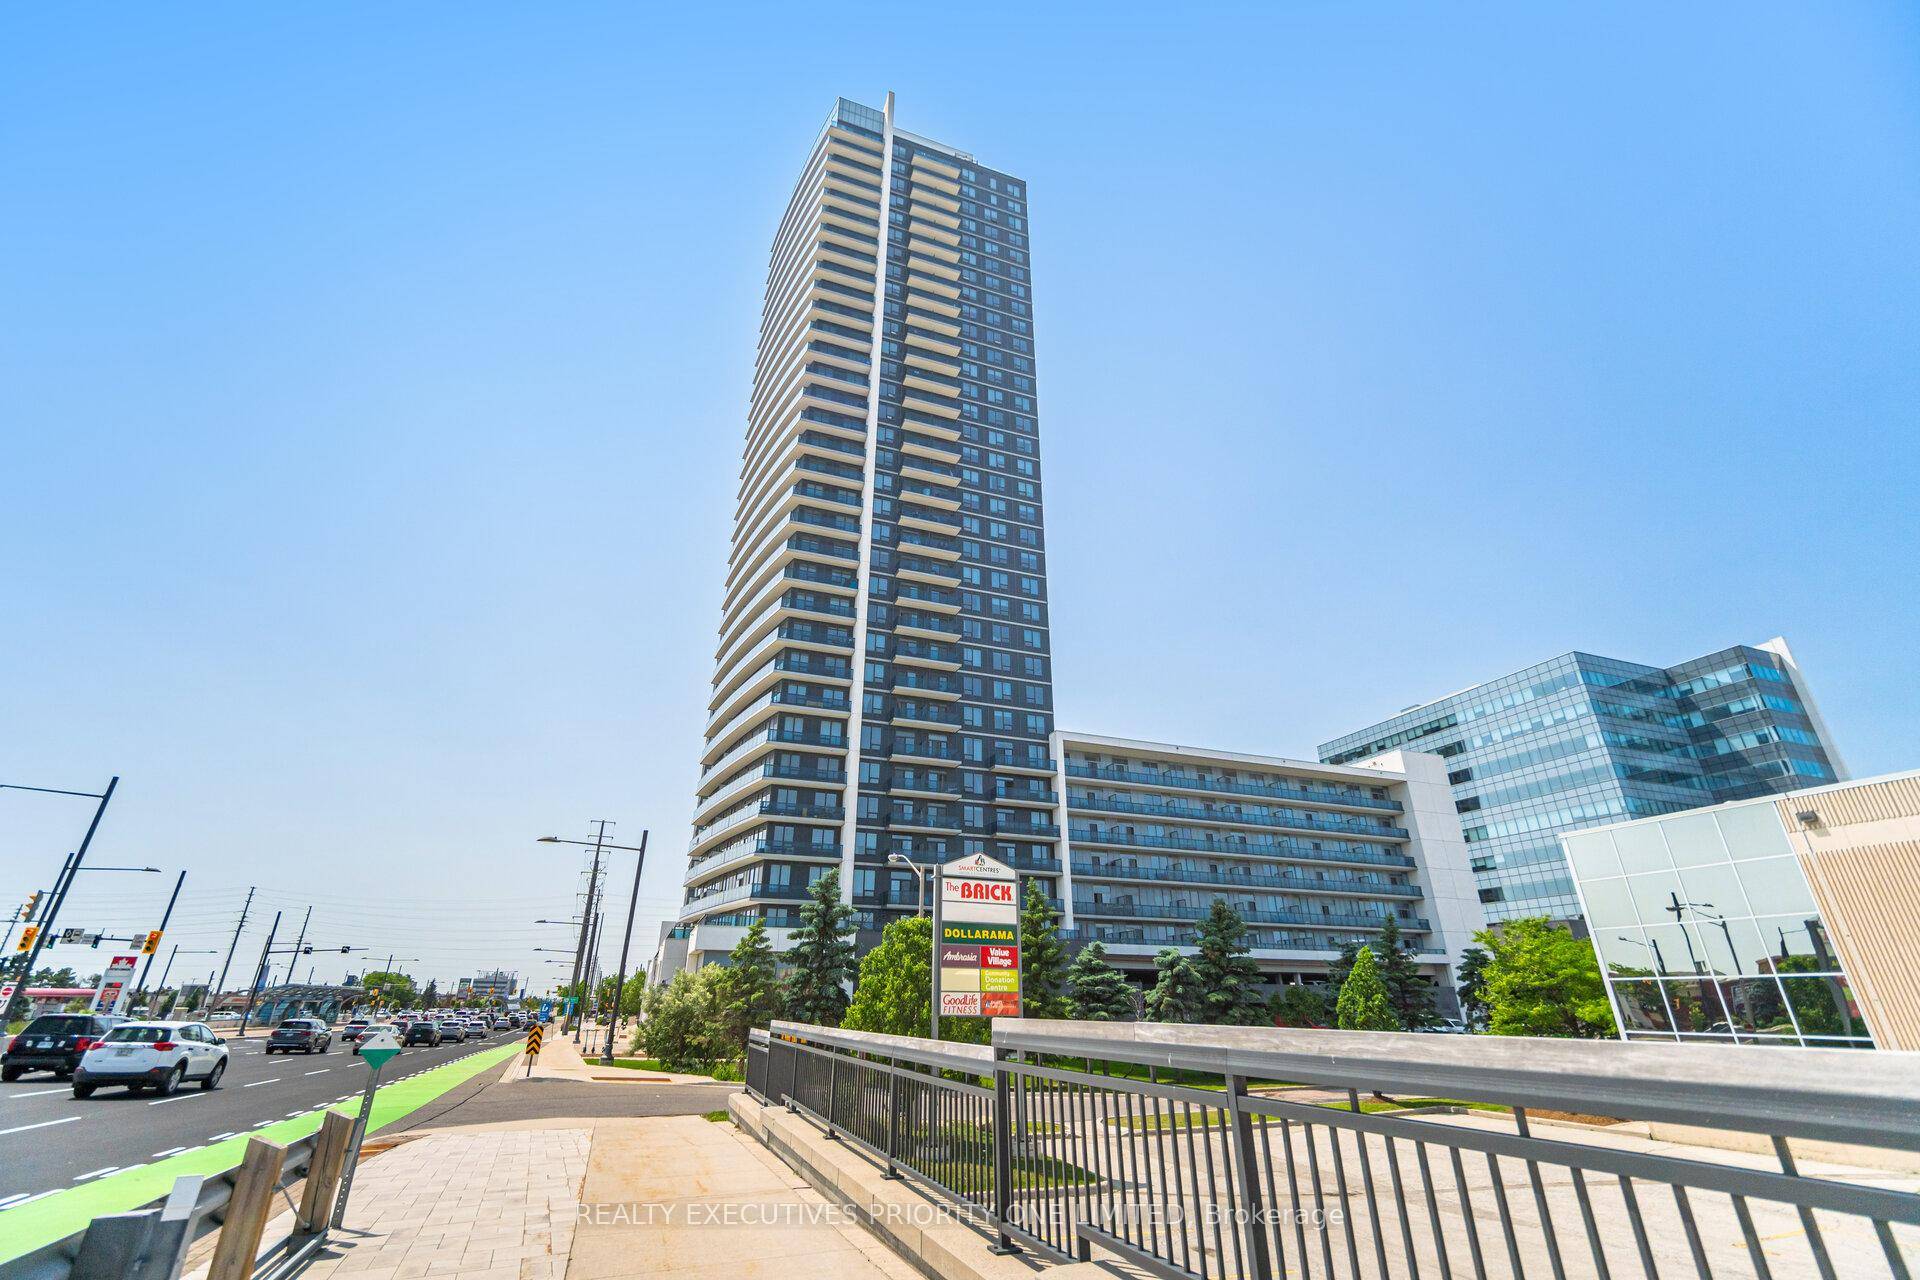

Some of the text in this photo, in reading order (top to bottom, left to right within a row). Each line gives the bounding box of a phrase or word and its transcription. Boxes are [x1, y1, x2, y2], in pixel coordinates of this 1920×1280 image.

[958, 865, 1000, 874] SMARTCENTRES
[945, 881, 1012, 901] The BRICK
[944, 928, 1014, 941] DOLLARAMA
[943, 951, 977, 962] Ambrosia
[989, 948, 1010, 957] Value
[987, 957, 1012, 967] Village
[985, 976, 1015, 984] Donation
[943, 994, 978, 1006] GoodLife
[943, 1005, 977, 1015] FITNESS
